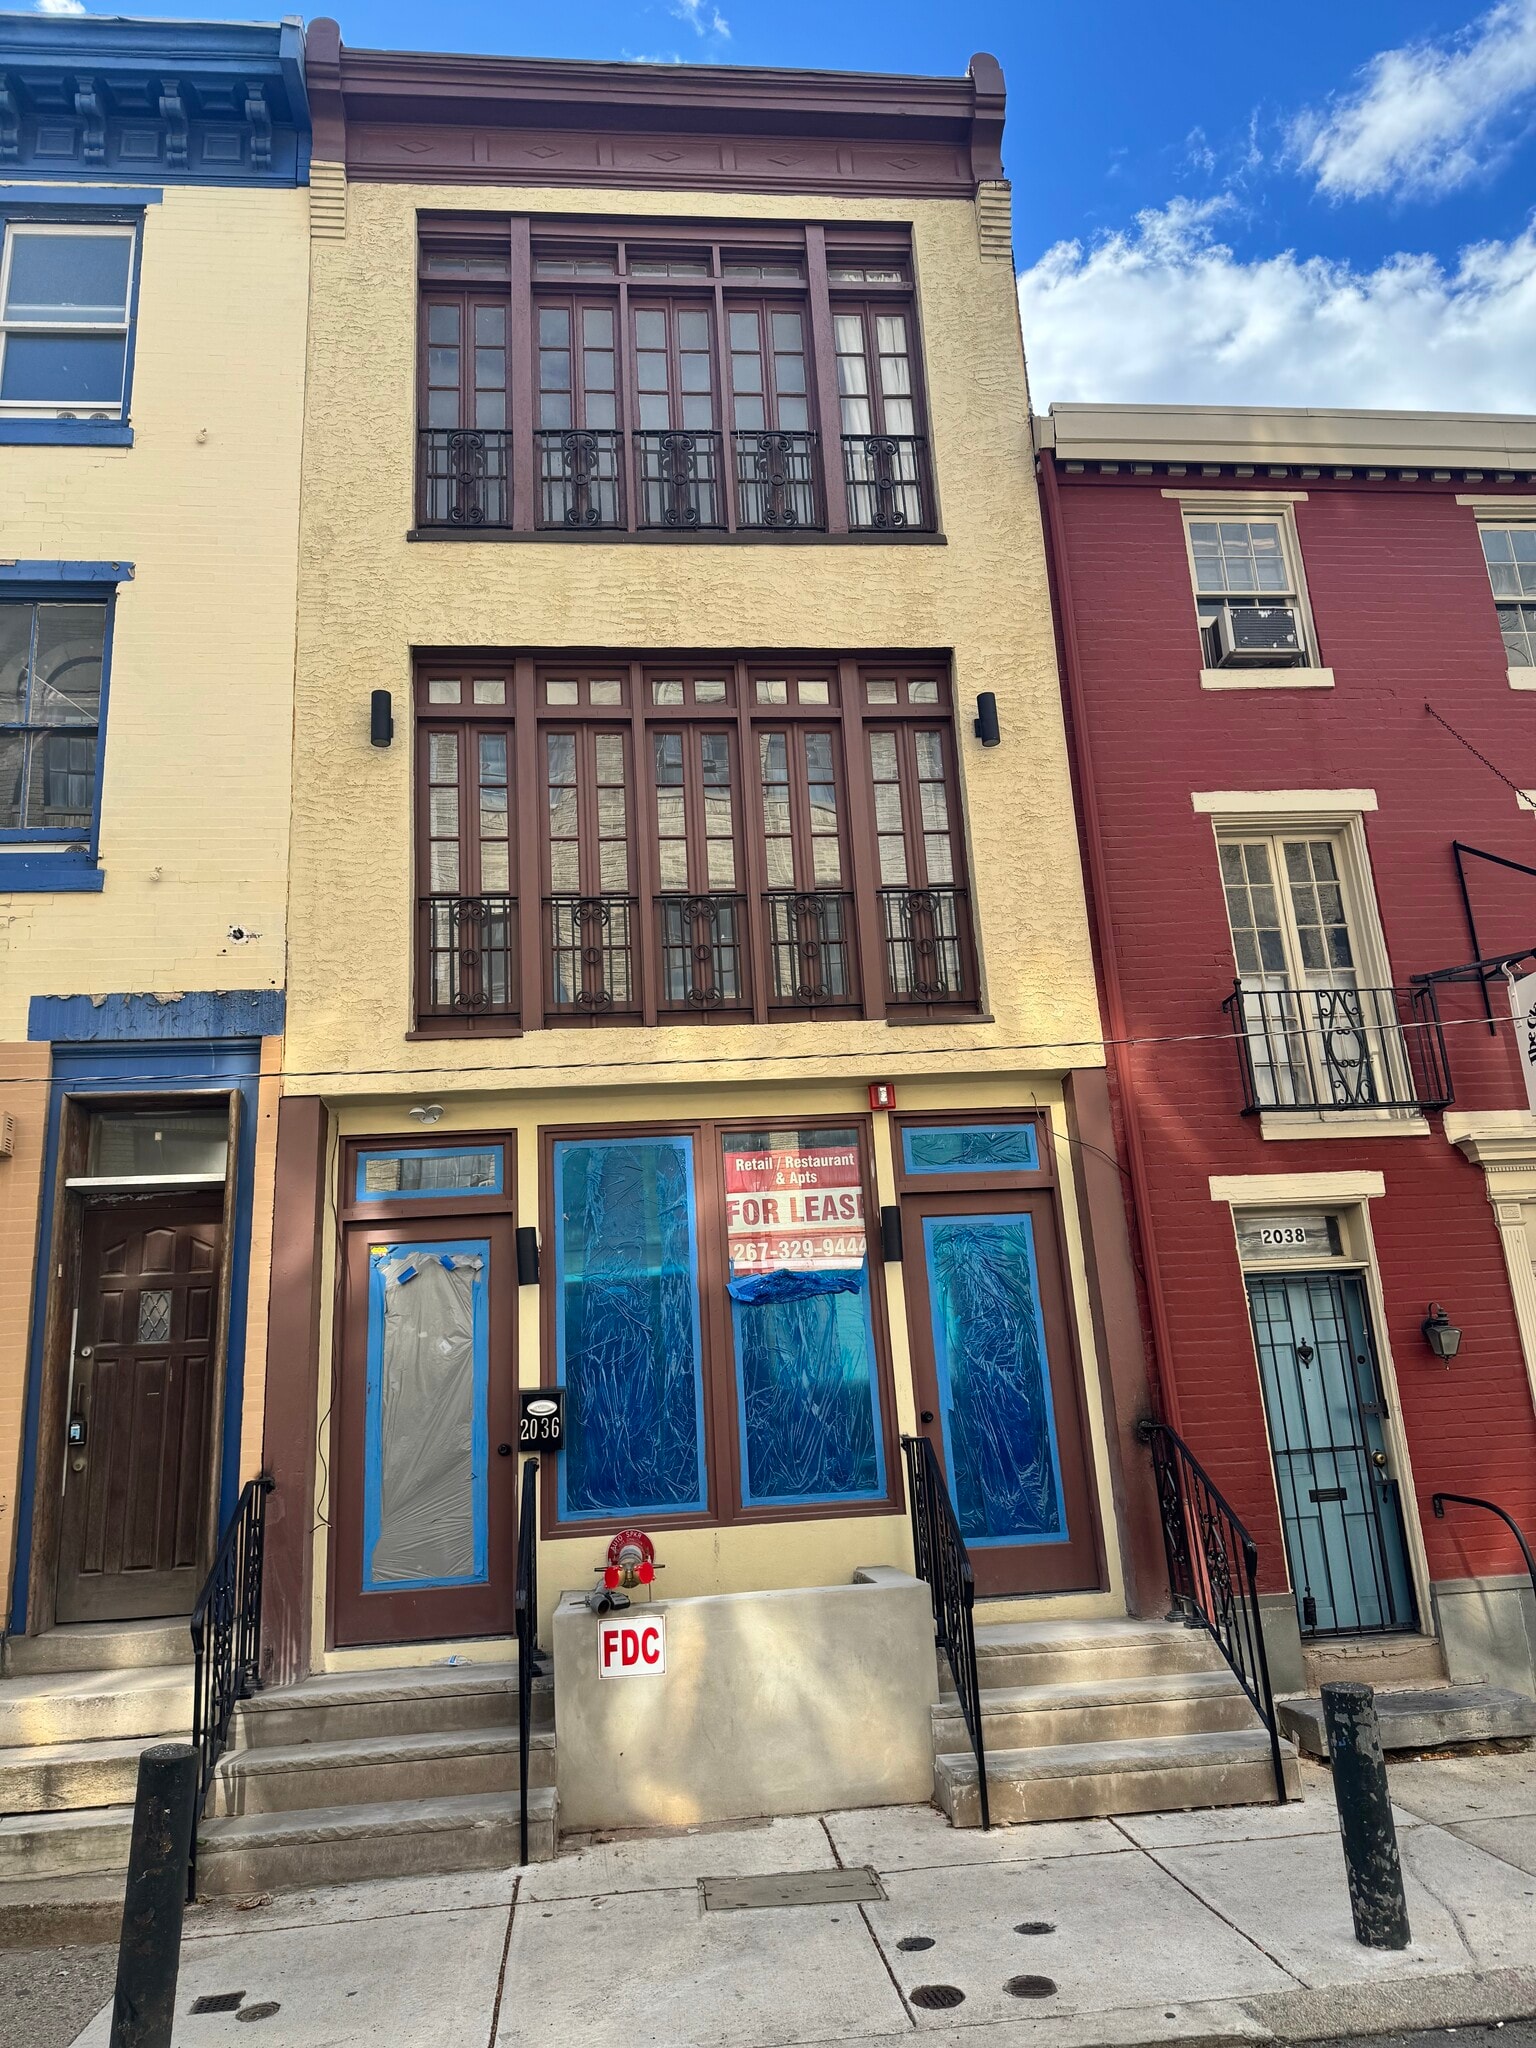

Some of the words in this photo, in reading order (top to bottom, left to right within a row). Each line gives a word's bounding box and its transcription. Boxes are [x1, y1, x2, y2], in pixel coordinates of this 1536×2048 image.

[735, 1157, 773, 1172] Retail
[785, 1153, 855, 1169] Restaurant
[775, 1171, 785, 1185] &
[790, 1171, 818, 1186] Apts
[726, 1198, 780, 1227] FOR
[1262, 1228, 1305, 1244] 2038
[520, 1416, 560, 1440] 2036
[610, 1534, 623, 1551] AUTO
[603, 1626, 660, 1667] FDC
